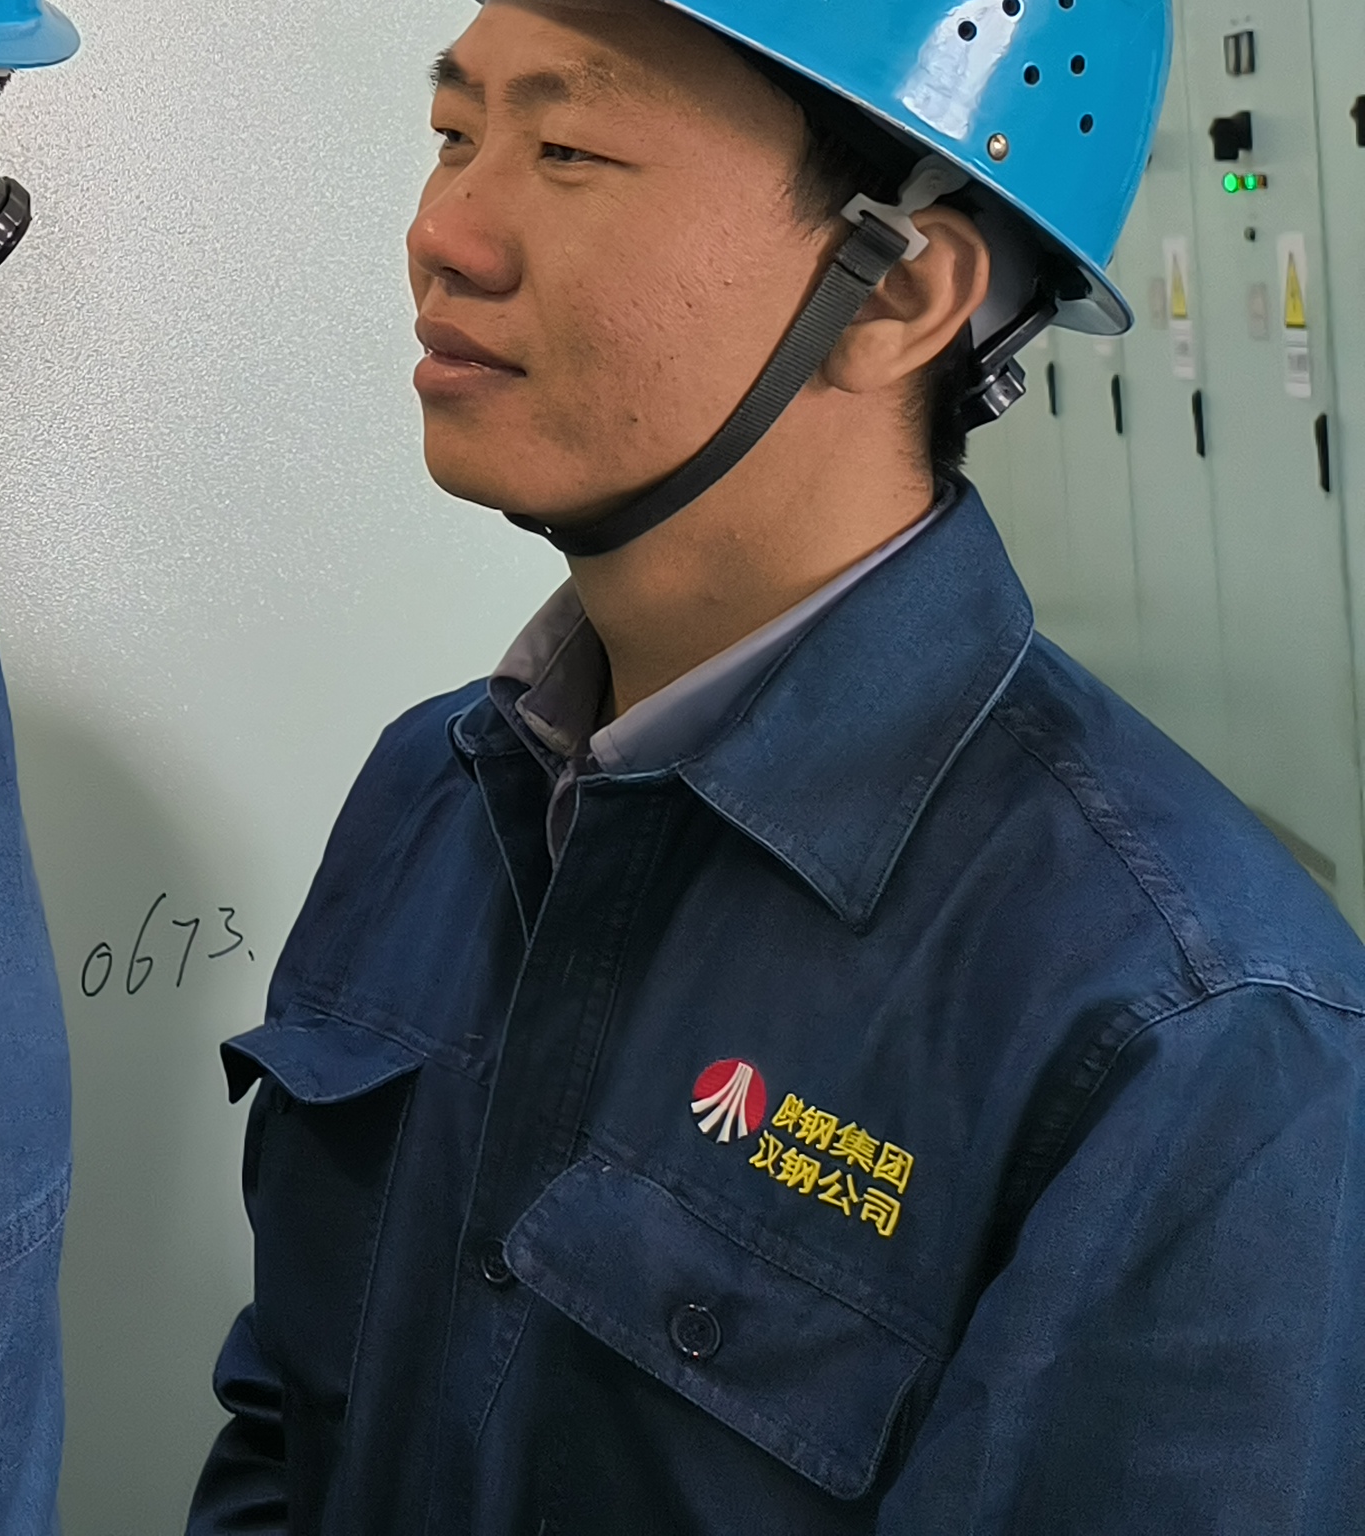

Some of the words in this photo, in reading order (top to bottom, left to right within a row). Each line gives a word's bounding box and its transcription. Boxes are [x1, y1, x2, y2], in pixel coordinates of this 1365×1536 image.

[748, 1129, 902, 1238] 汉钢公司
[771, 1092, 915, 1195] 陕钢集团
